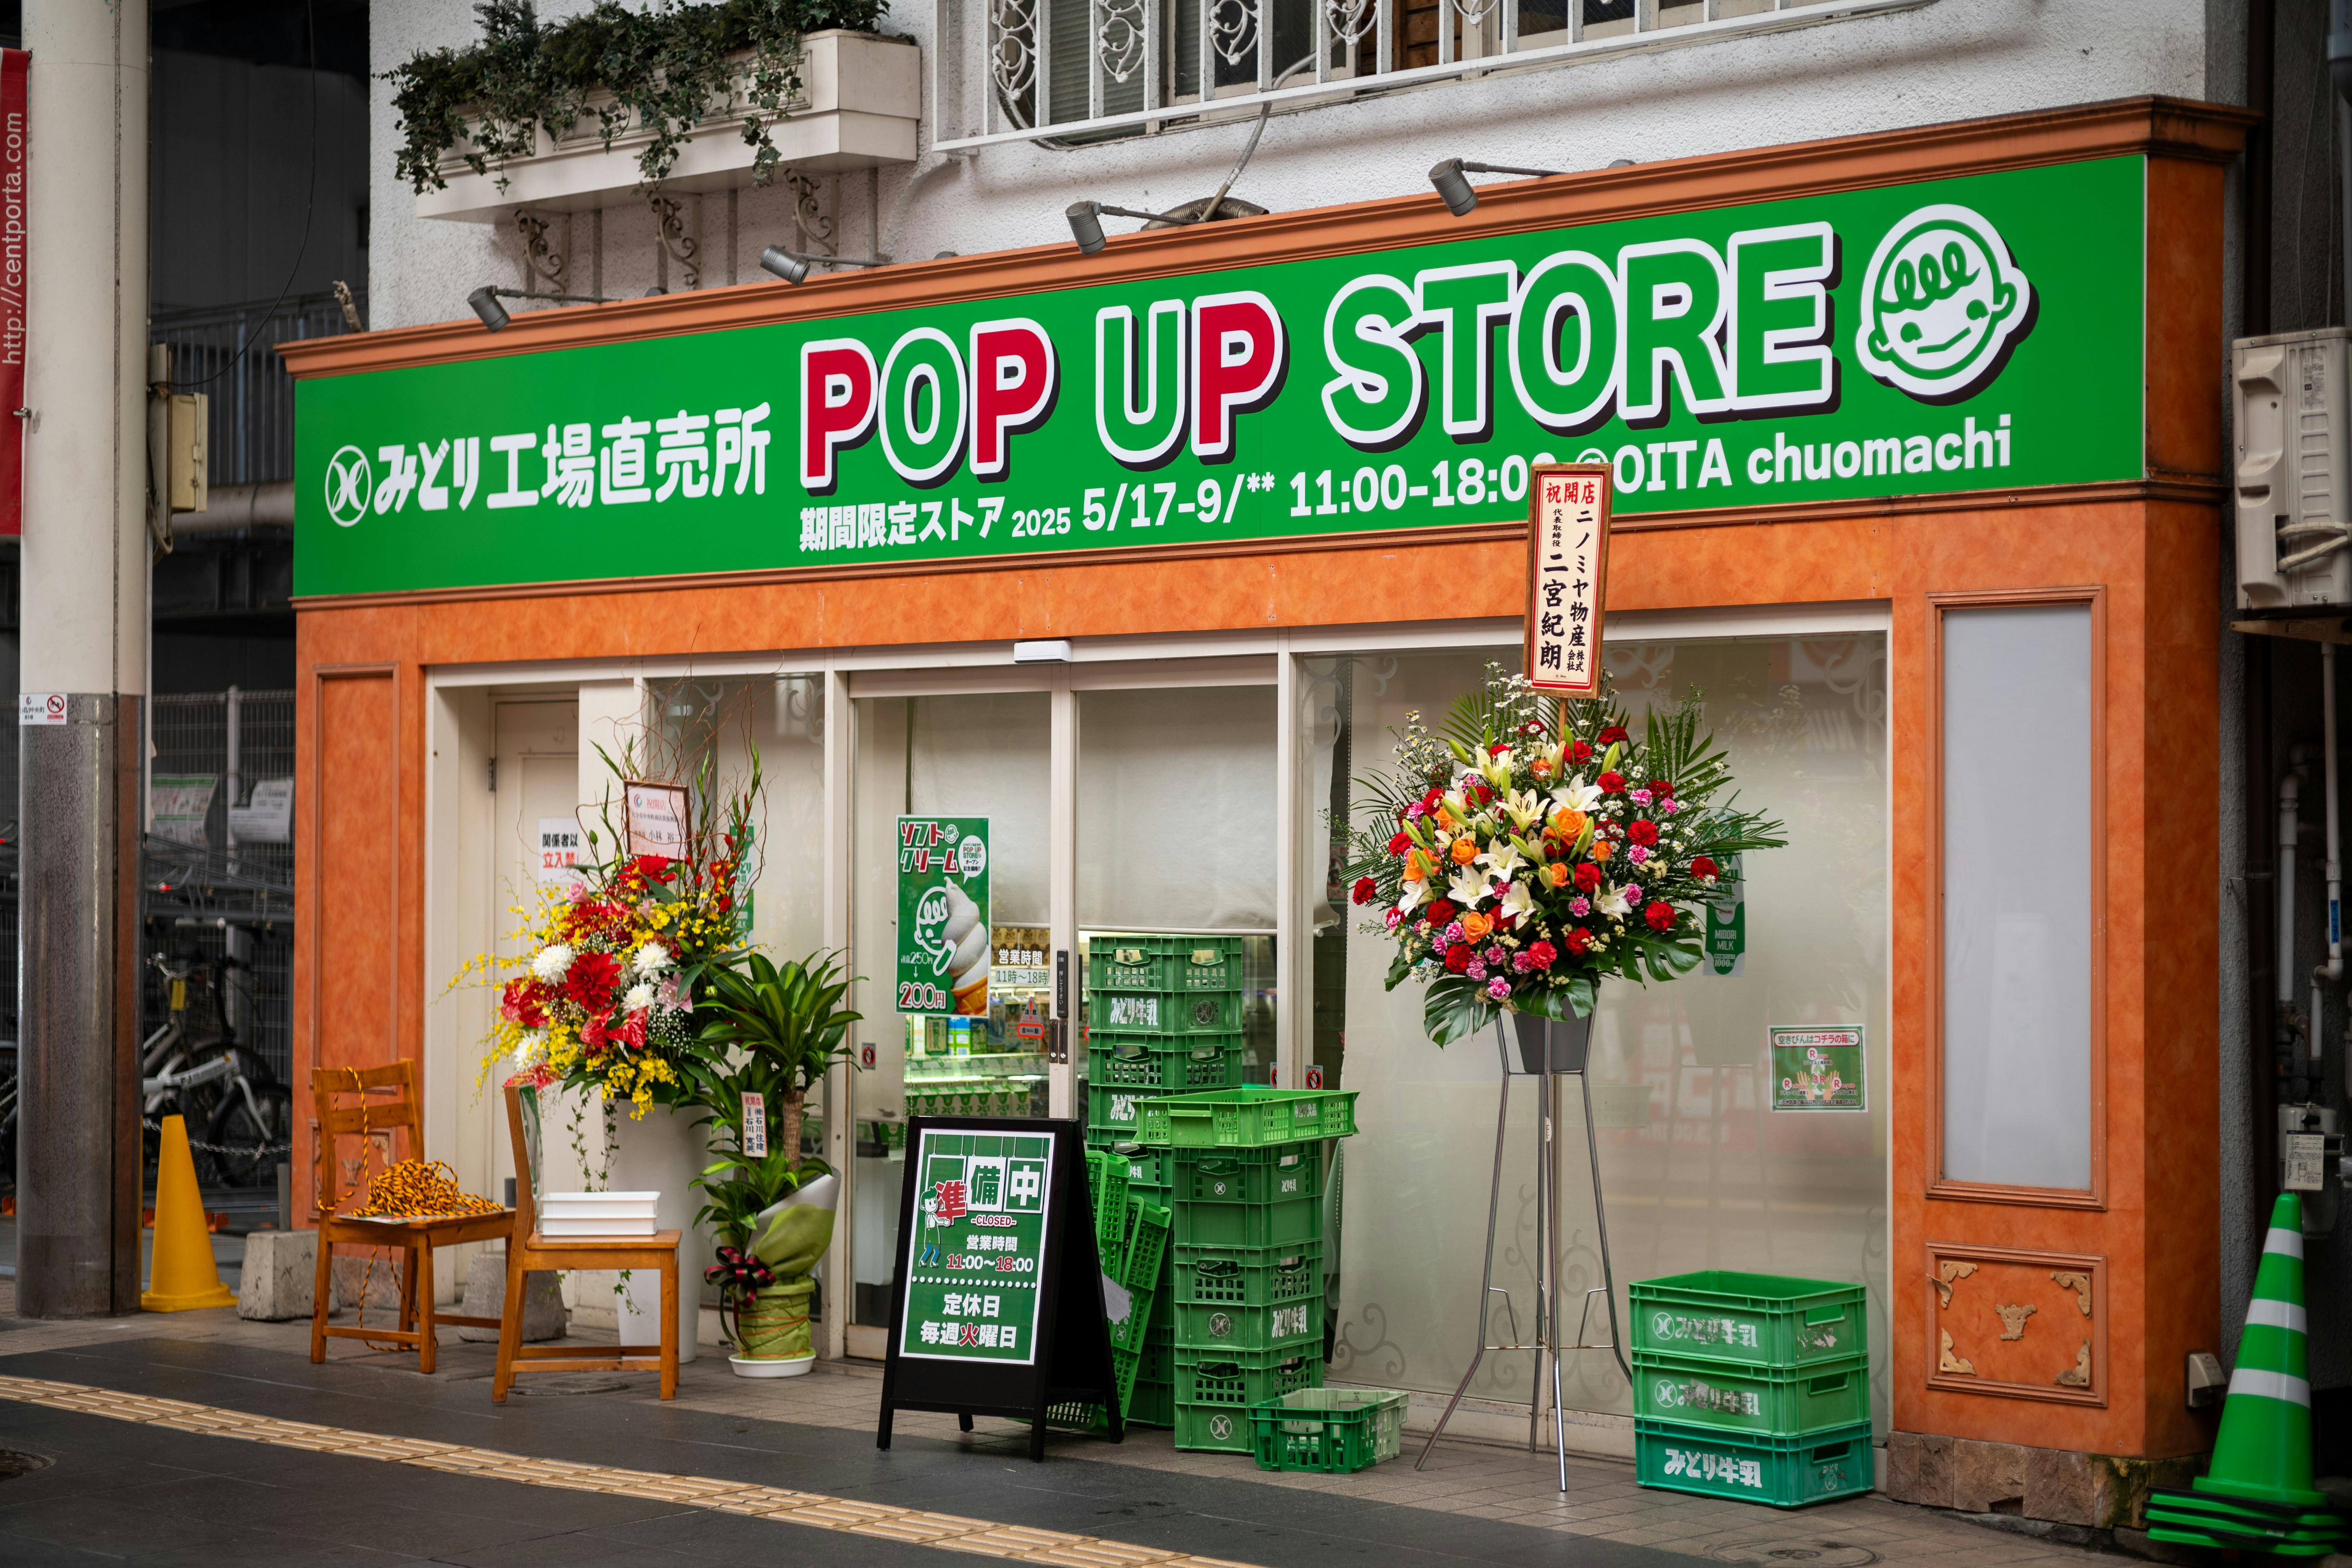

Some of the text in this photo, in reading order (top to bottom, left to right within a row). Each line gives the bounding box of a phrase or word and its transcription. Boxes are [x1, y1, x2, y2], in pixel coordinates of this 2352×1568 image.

[0, 112, 26, 365] http://centporta.com
[800, 221, 1835, 491] POP UP STORE
[374, 401, 771, 515] みどり工場直売所
[800, 496, 1005, 553] 期間限定ストア
[1012, 507, 1071, 537] 2025
[1290, 452, 1557, 516] 11:00-18:0
[1575, 437, 1732, 494] OITA
[1749, 413, 2011, 483] chuomachi
[1546, 481, 1596, 505] 祝開店
[1552, 509, 1563, 547] 代表取締役
[1540, 553, 1569, 670] 二宮紀朗
[647, 798, 666, 811] 祝開店
[649, 829, 663, 842] 小林
[901, 821, 944, 847] ソフト
[738, 862, 751, 874] どり
[901, 848, 959, 873] クリーム
[1715, 929, 1736, 939] MIDORI
[1717, 940, 1734, 950] MILK
[999, 948, 1043, 966] 営業時間
[899, 981, 946, 1010] 200円
[1110, 997, 1158, 1026] みどり牛乳
[1778, 1034, 1855, 1045] 空きびんはコチラの箱に
[1810, 1050, 1829, 1059] Reuse
[1784, 1080, 1806, 1088] Reduce
[1834, 1079, 1856, 1089] Recycle
[745, 1096, 761, 1106] 祝開店
[746, 1118, 754, 1133] 石川
[935, 1165, 1040, 1225] 準備中
[1281, 1178, 1297, 1192] みどり牛乳
[966, 1234, 1018, 1252] 営業時間
[942, 1293, 1000, 1318] 定休日
[1272, 1305, 1307, 1338] みどり牛乳
[920, 1320, 1017, 1349] 毎週火曜日
[1664, 1448, 1762, 1488] みどり牛乳
[1823, 1463, 1838, 1474] みどり
